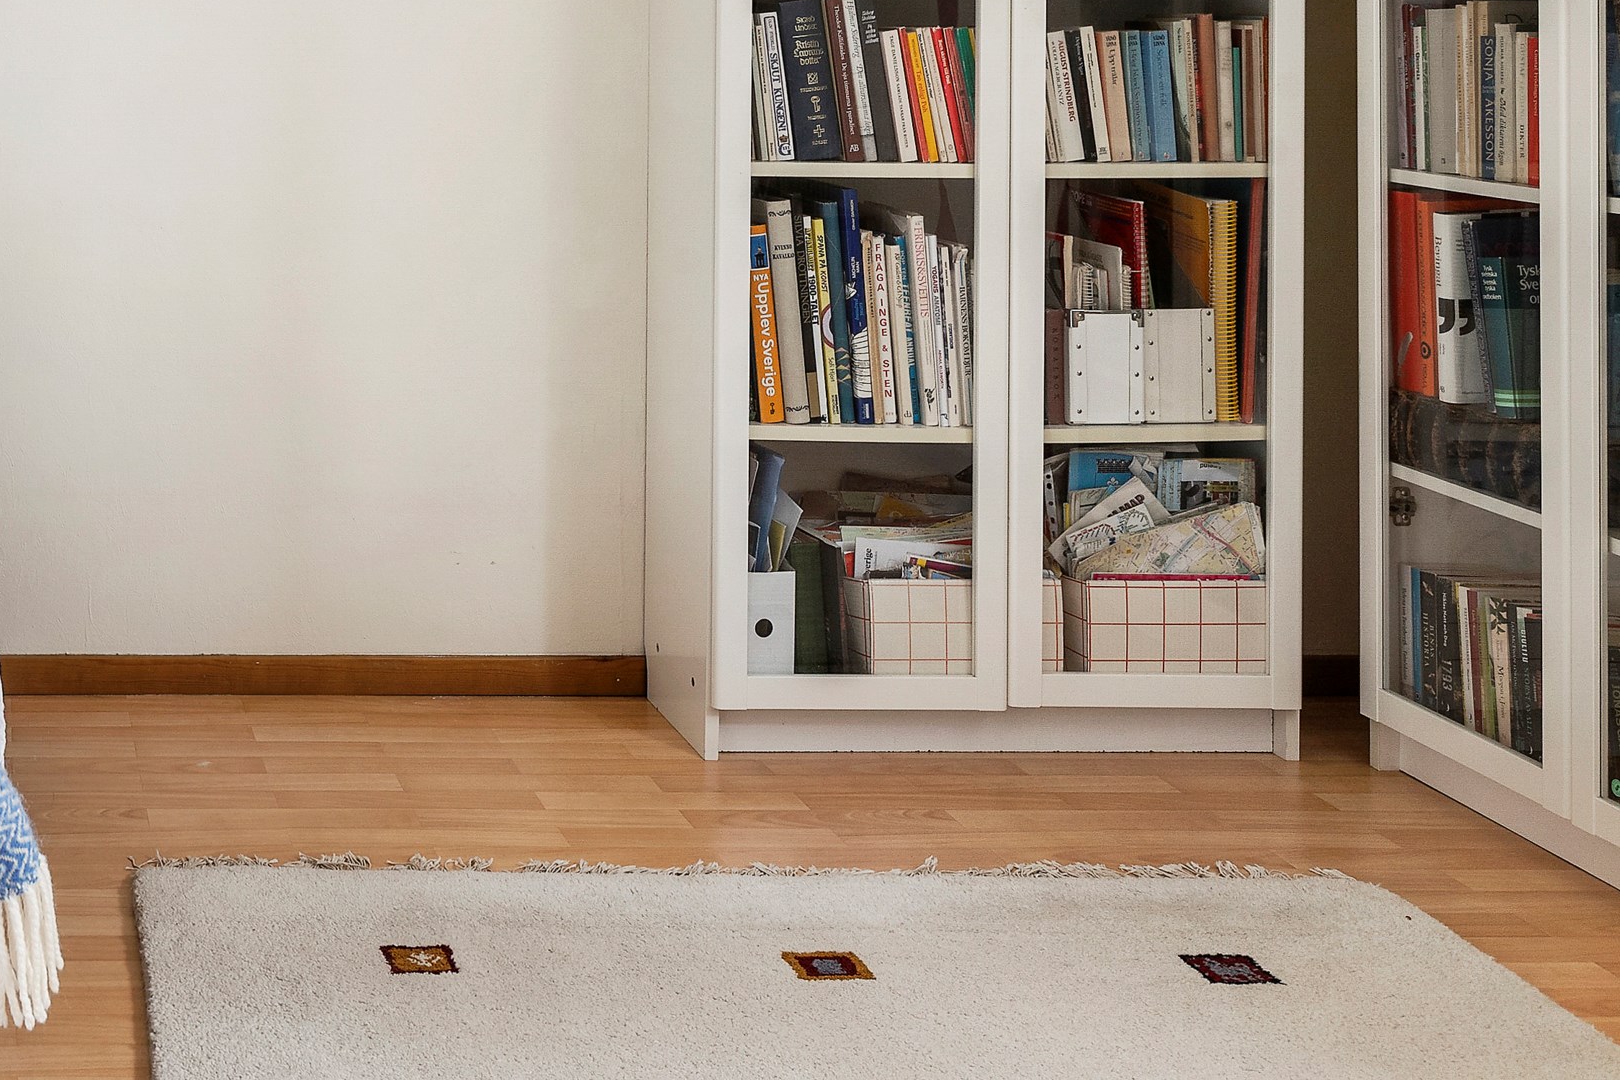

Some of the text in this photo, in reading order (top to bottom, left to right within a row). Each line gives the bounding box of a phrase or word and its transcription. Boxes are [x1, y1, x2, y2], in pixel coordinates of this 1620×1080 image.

[1484, 38, 1494, 81] SONJA
[770, 52, 786, 132] SKJUT KUNGEN!
[1058, 40, 1076, 122] AUGUST STRINDBERG
[793, 215, 804, 247] SILVIA
[753, 274, 768, 282] NYA
[817, 235, 828, 293] SPANA PÅ KONST
[914, 227, 930, 318] FRISKIS&SVETTIS
[931, 265, 939, 293] YOGANS
[796, 250, 811, 324] DROTTNINGEN
[809, 275, 820, 326] 1900-TALET
[959, 286, 967, 324] BARNENS
[879, 298, 889, 337] INGE
[756, 282, 777, 397] Upplev Sverige
[882, 344, 888, 352] &
[883, 360, 892, 398] STEN
[1442, 659, 1452, 691] 1793
